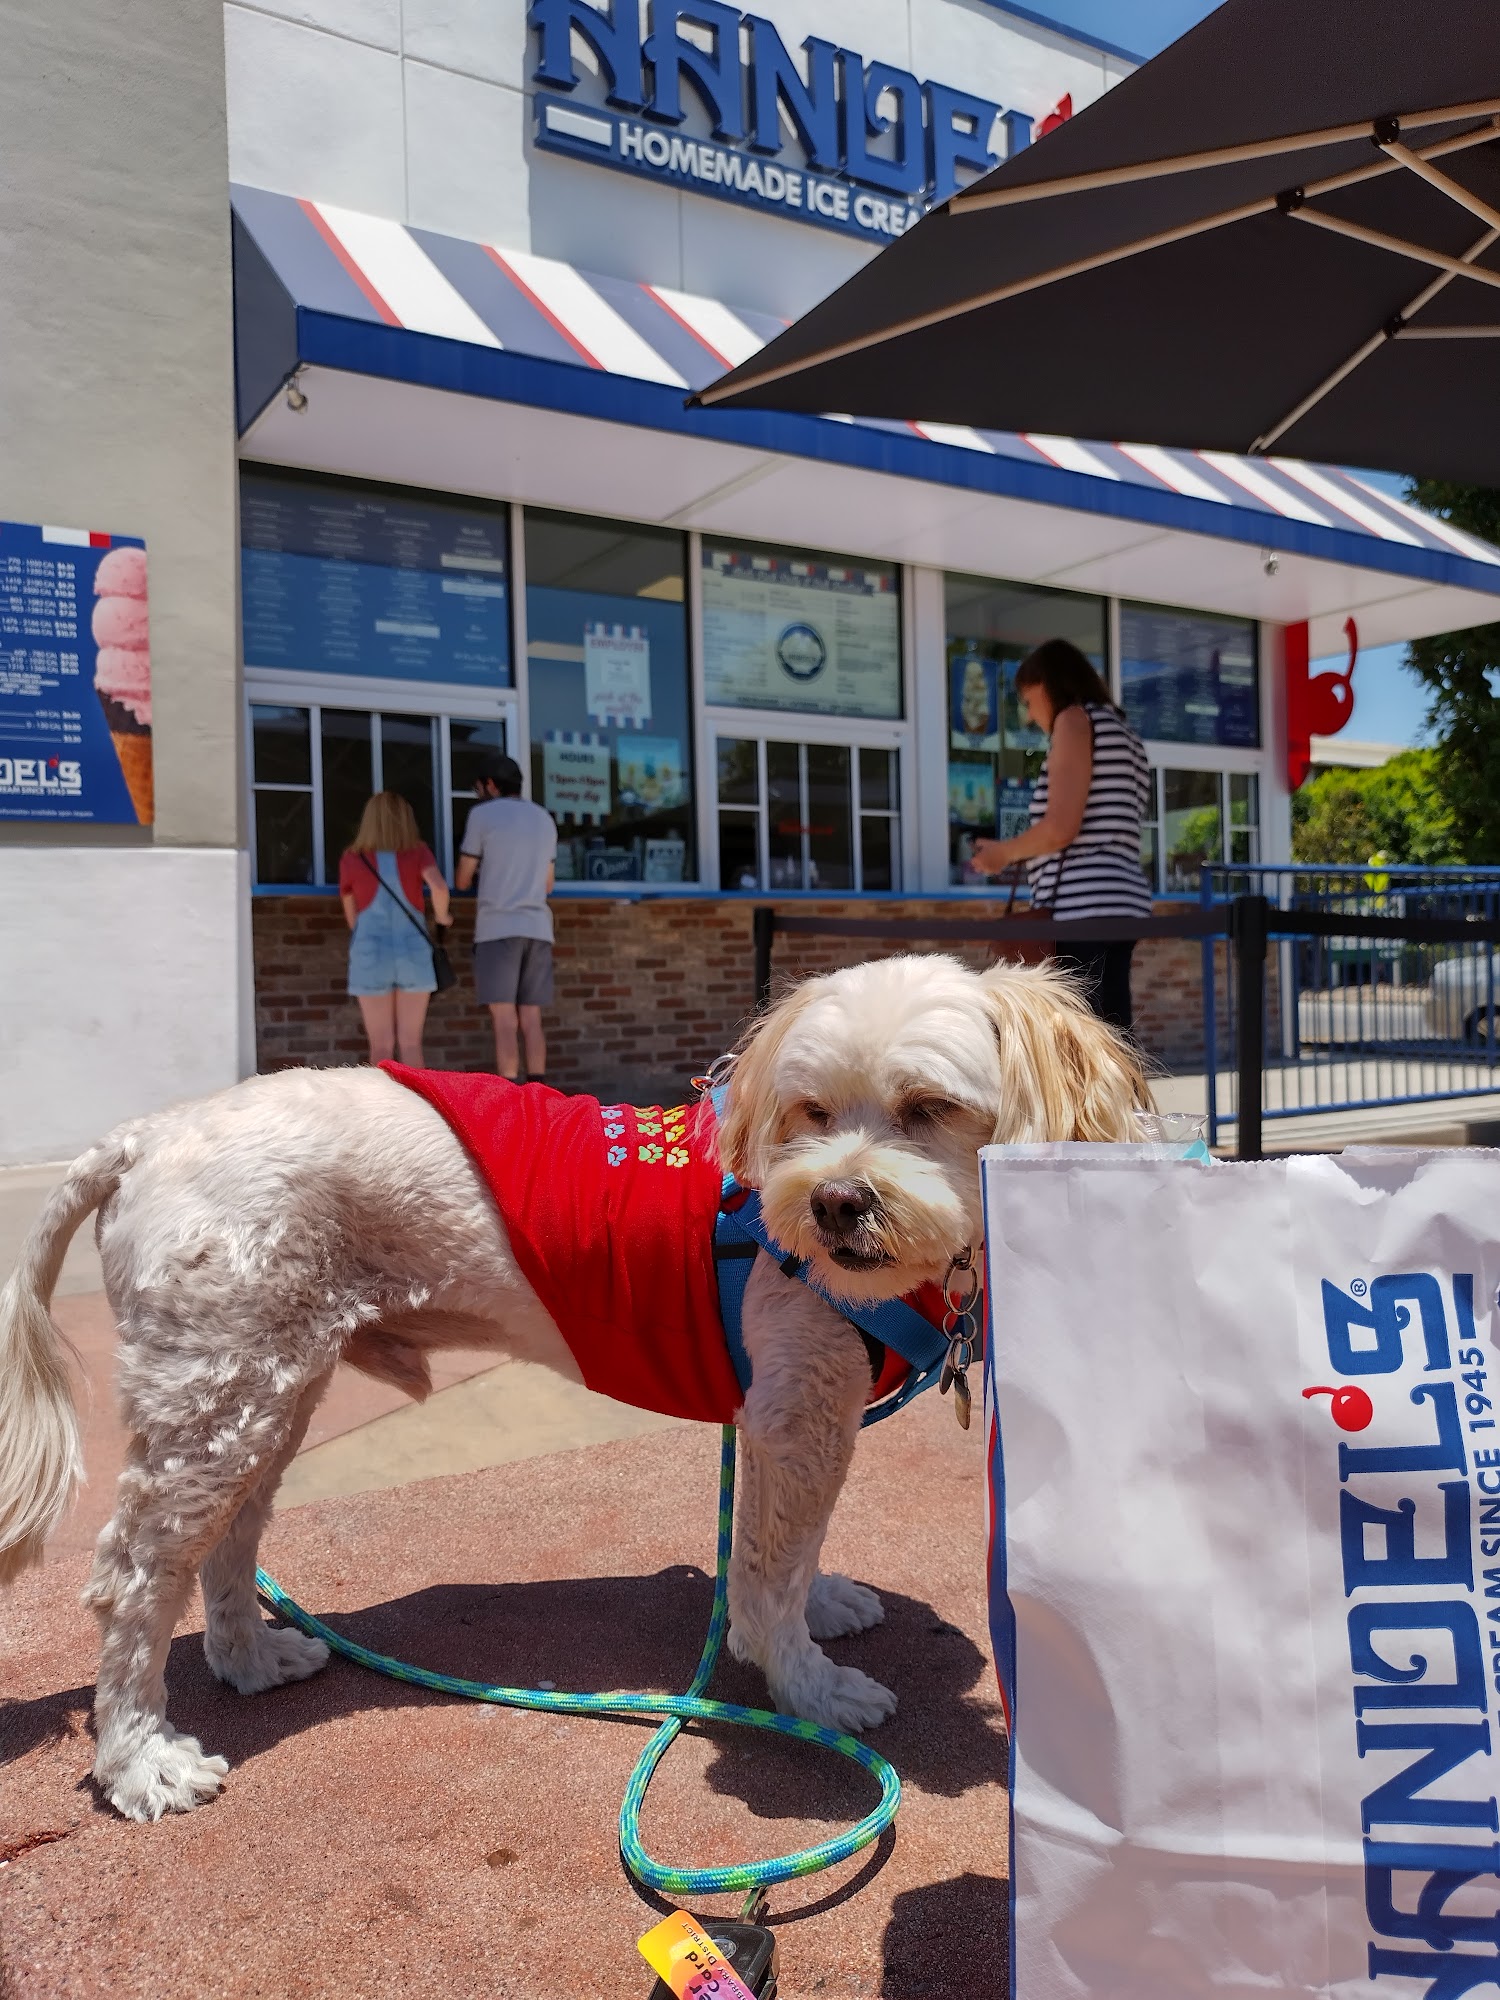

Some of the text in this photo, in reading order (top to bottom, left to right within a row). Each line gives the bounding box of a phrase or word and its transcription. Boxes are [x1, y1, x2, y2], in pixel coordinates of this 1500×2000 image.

[619, 121, 921, 238] HOMEMADE ICE CREA
[1458, 1347, 1496, 1434] 1945
[681, 1921, 718, 1966] DISTRICT
[684, 1950, 720, 1993] Card
